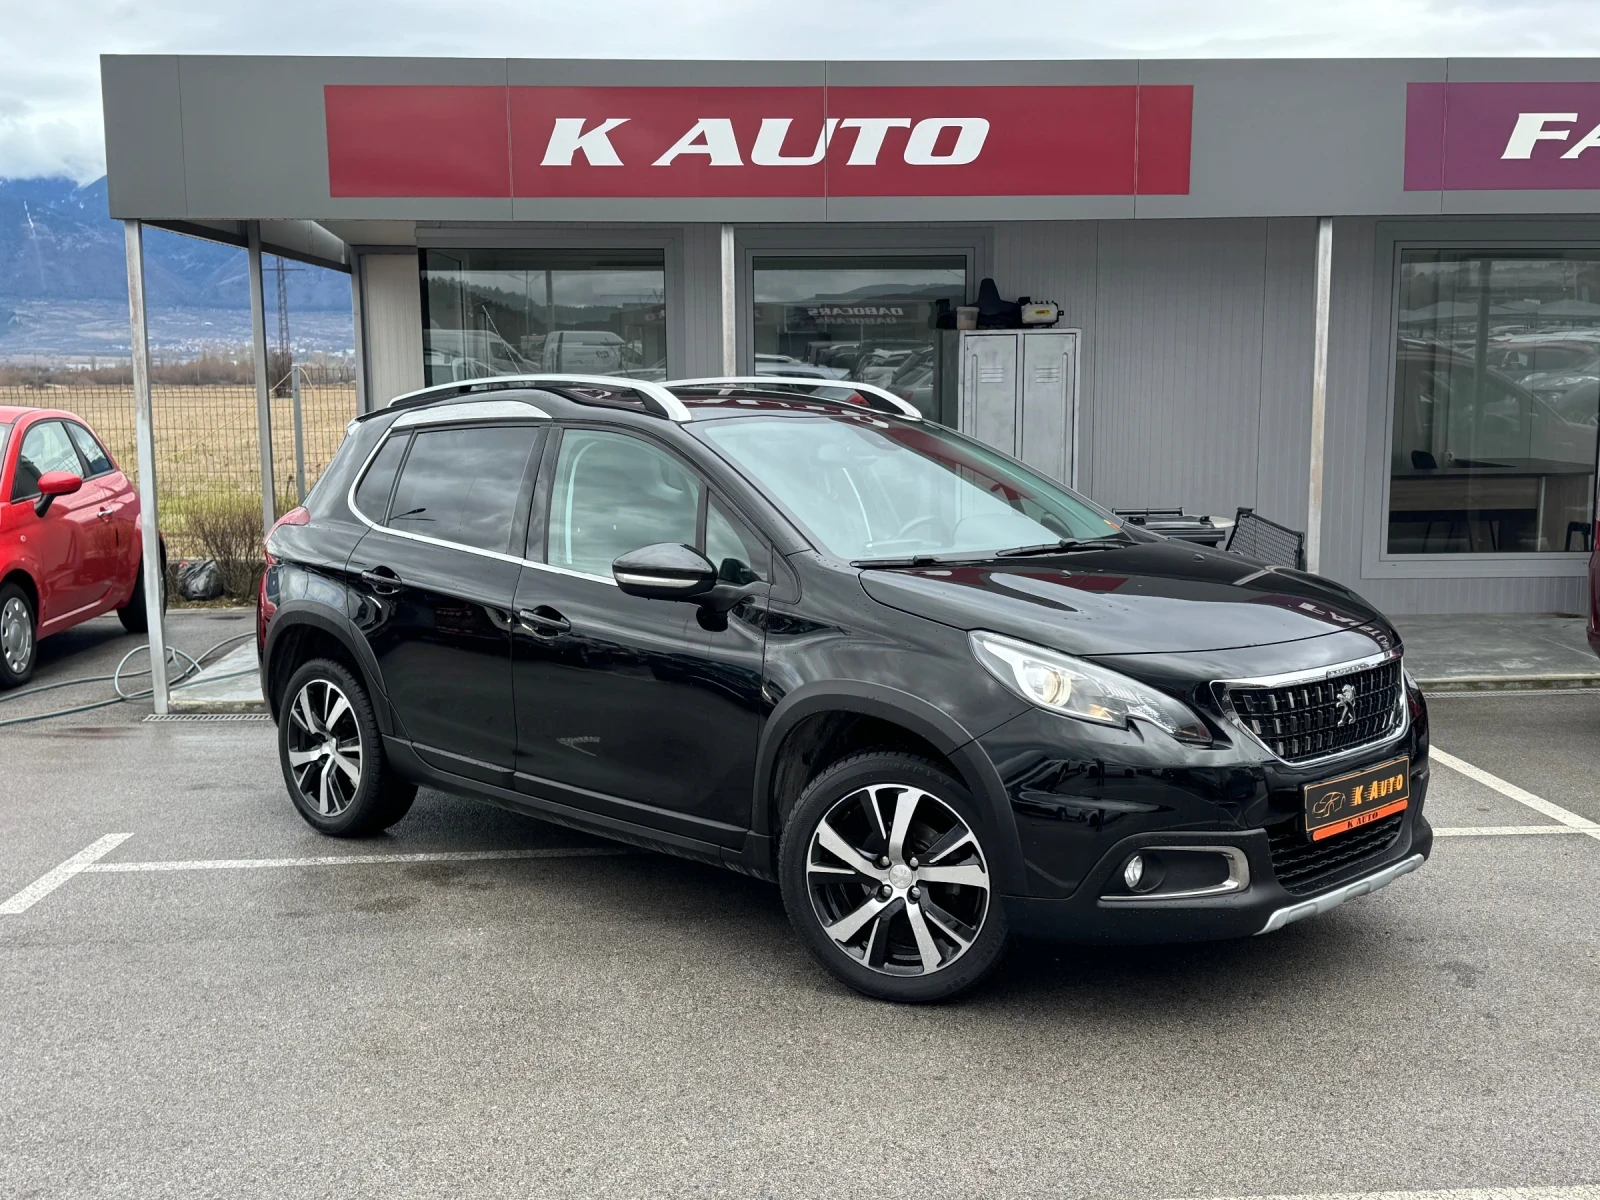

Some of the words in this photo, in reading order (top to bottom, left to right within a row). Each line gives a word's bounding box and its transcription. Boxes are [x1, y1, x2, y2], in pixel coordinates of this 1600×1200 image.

[539, 117, 631, 166] K
[651, 117, 990, 166] AUTO
[1350, 785, 1364, 807] K
[1366, 773, 1404, 802] AUTO
[1347, 819, 1355, 830] K
[1356, 812, 1379, 826] AUTO
